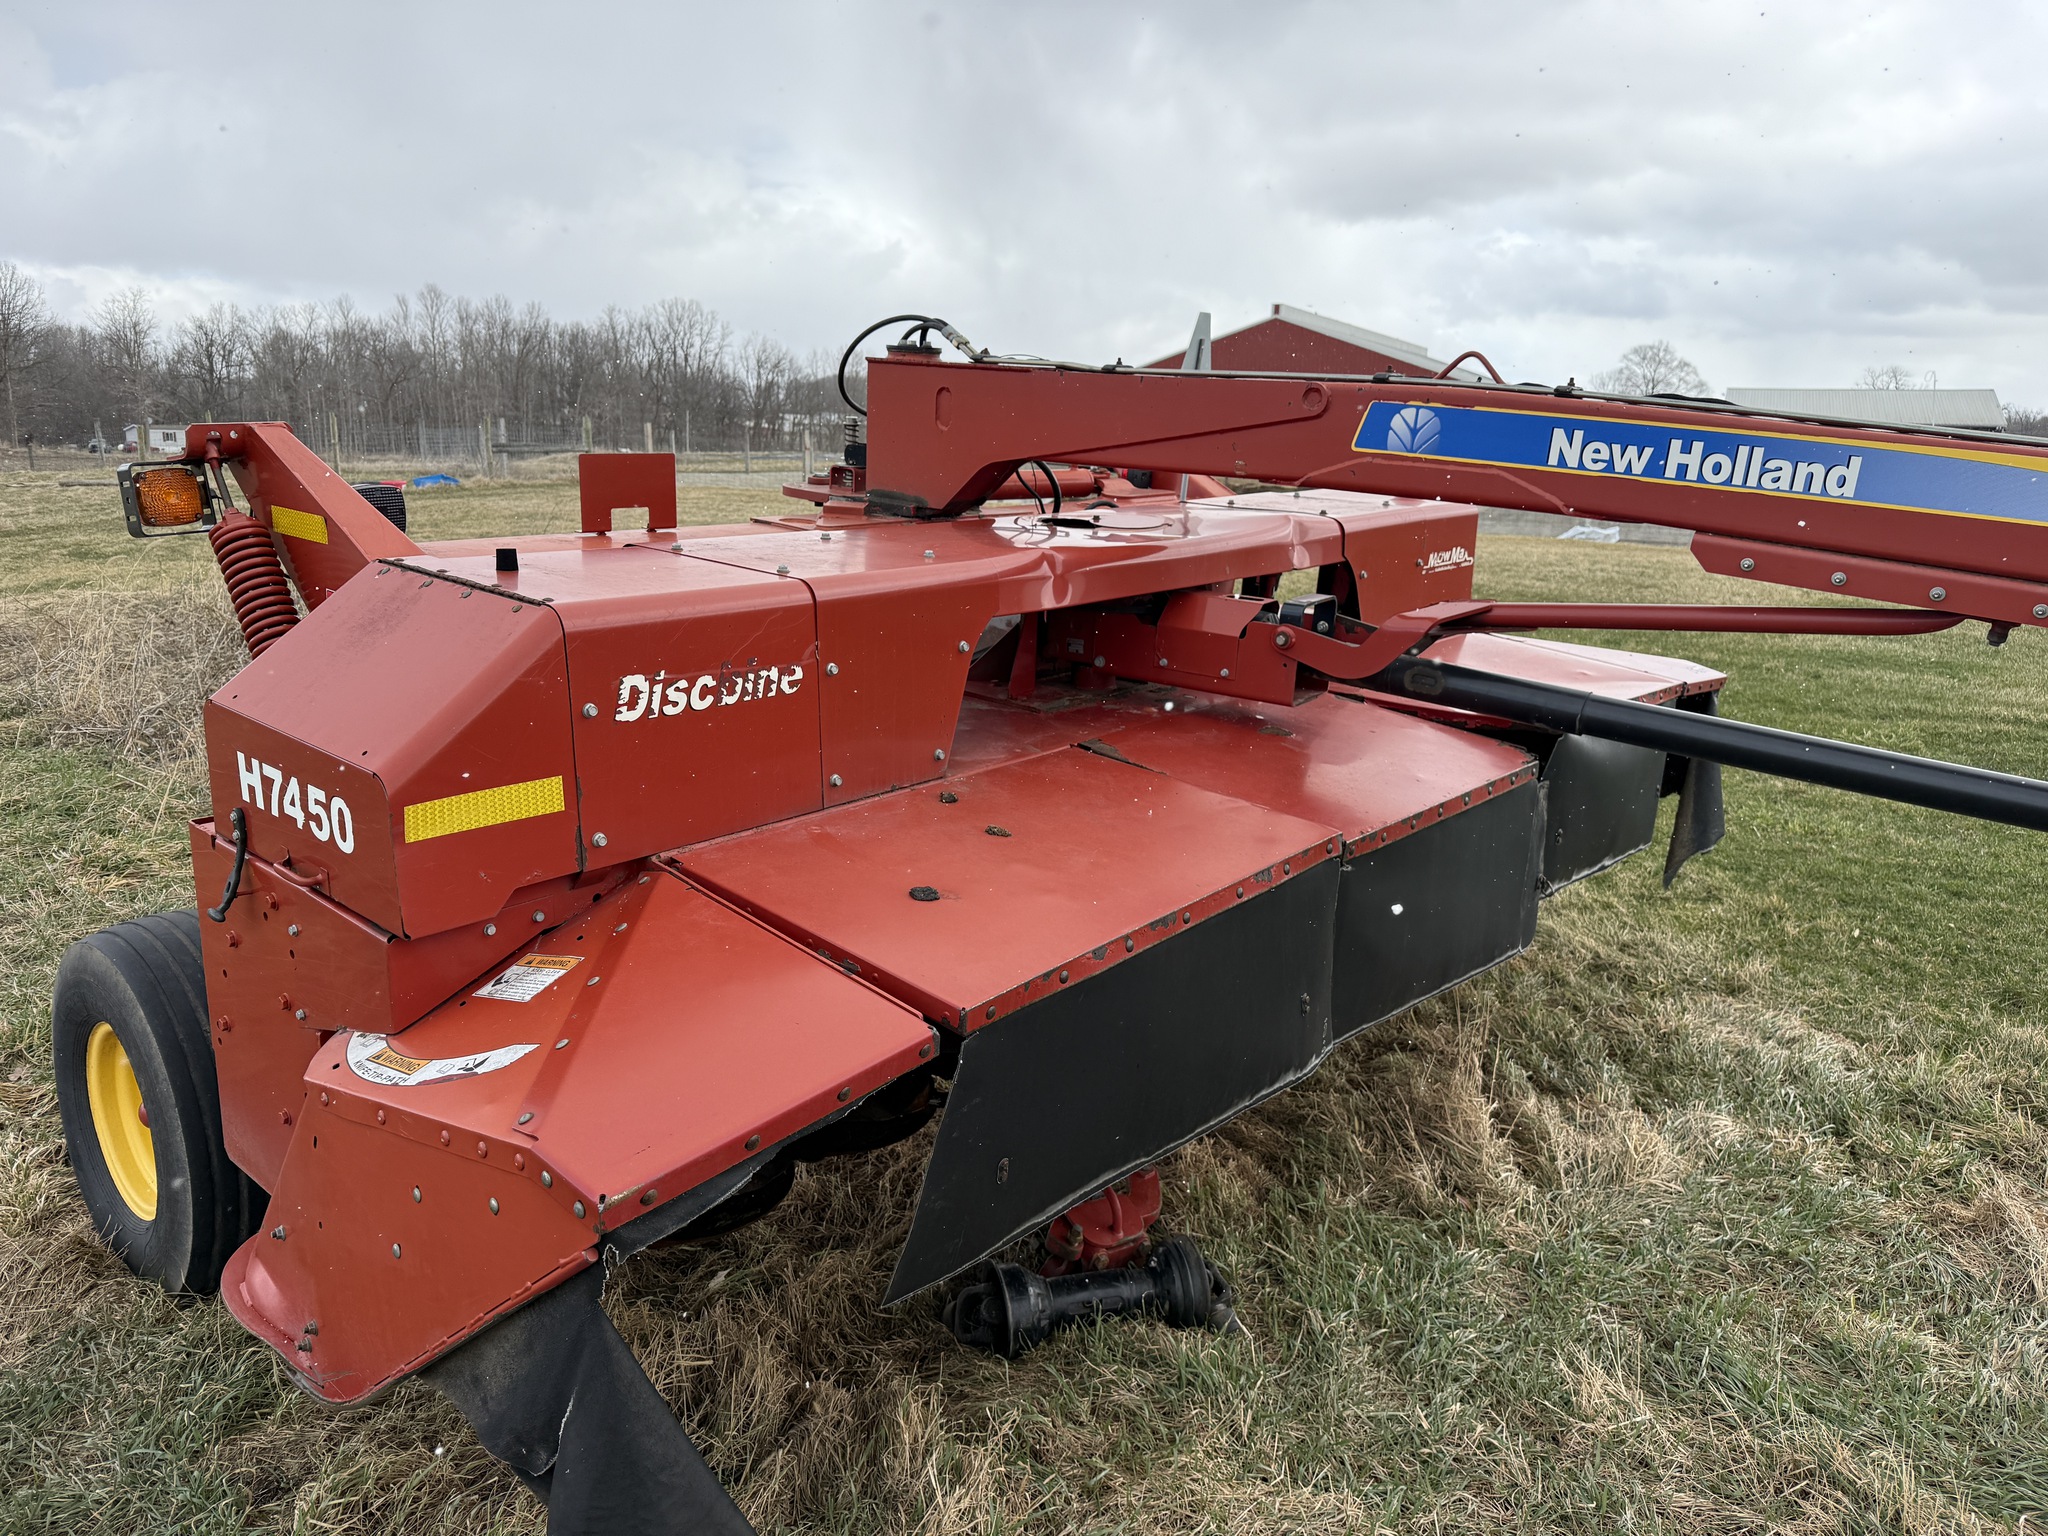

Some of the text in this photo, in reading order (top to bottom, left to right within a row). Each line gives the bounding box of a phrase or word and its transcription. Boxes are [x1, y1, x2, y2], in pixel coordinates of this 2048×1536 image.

[1548, 427, 1862, 498] New Holland
[614, 657, 803, 722] Discbine
[237, 750, 355, 854] H7450
[535, 959, 571, 967] WARNING
[382, 1053, 421, 1073] WARNING
